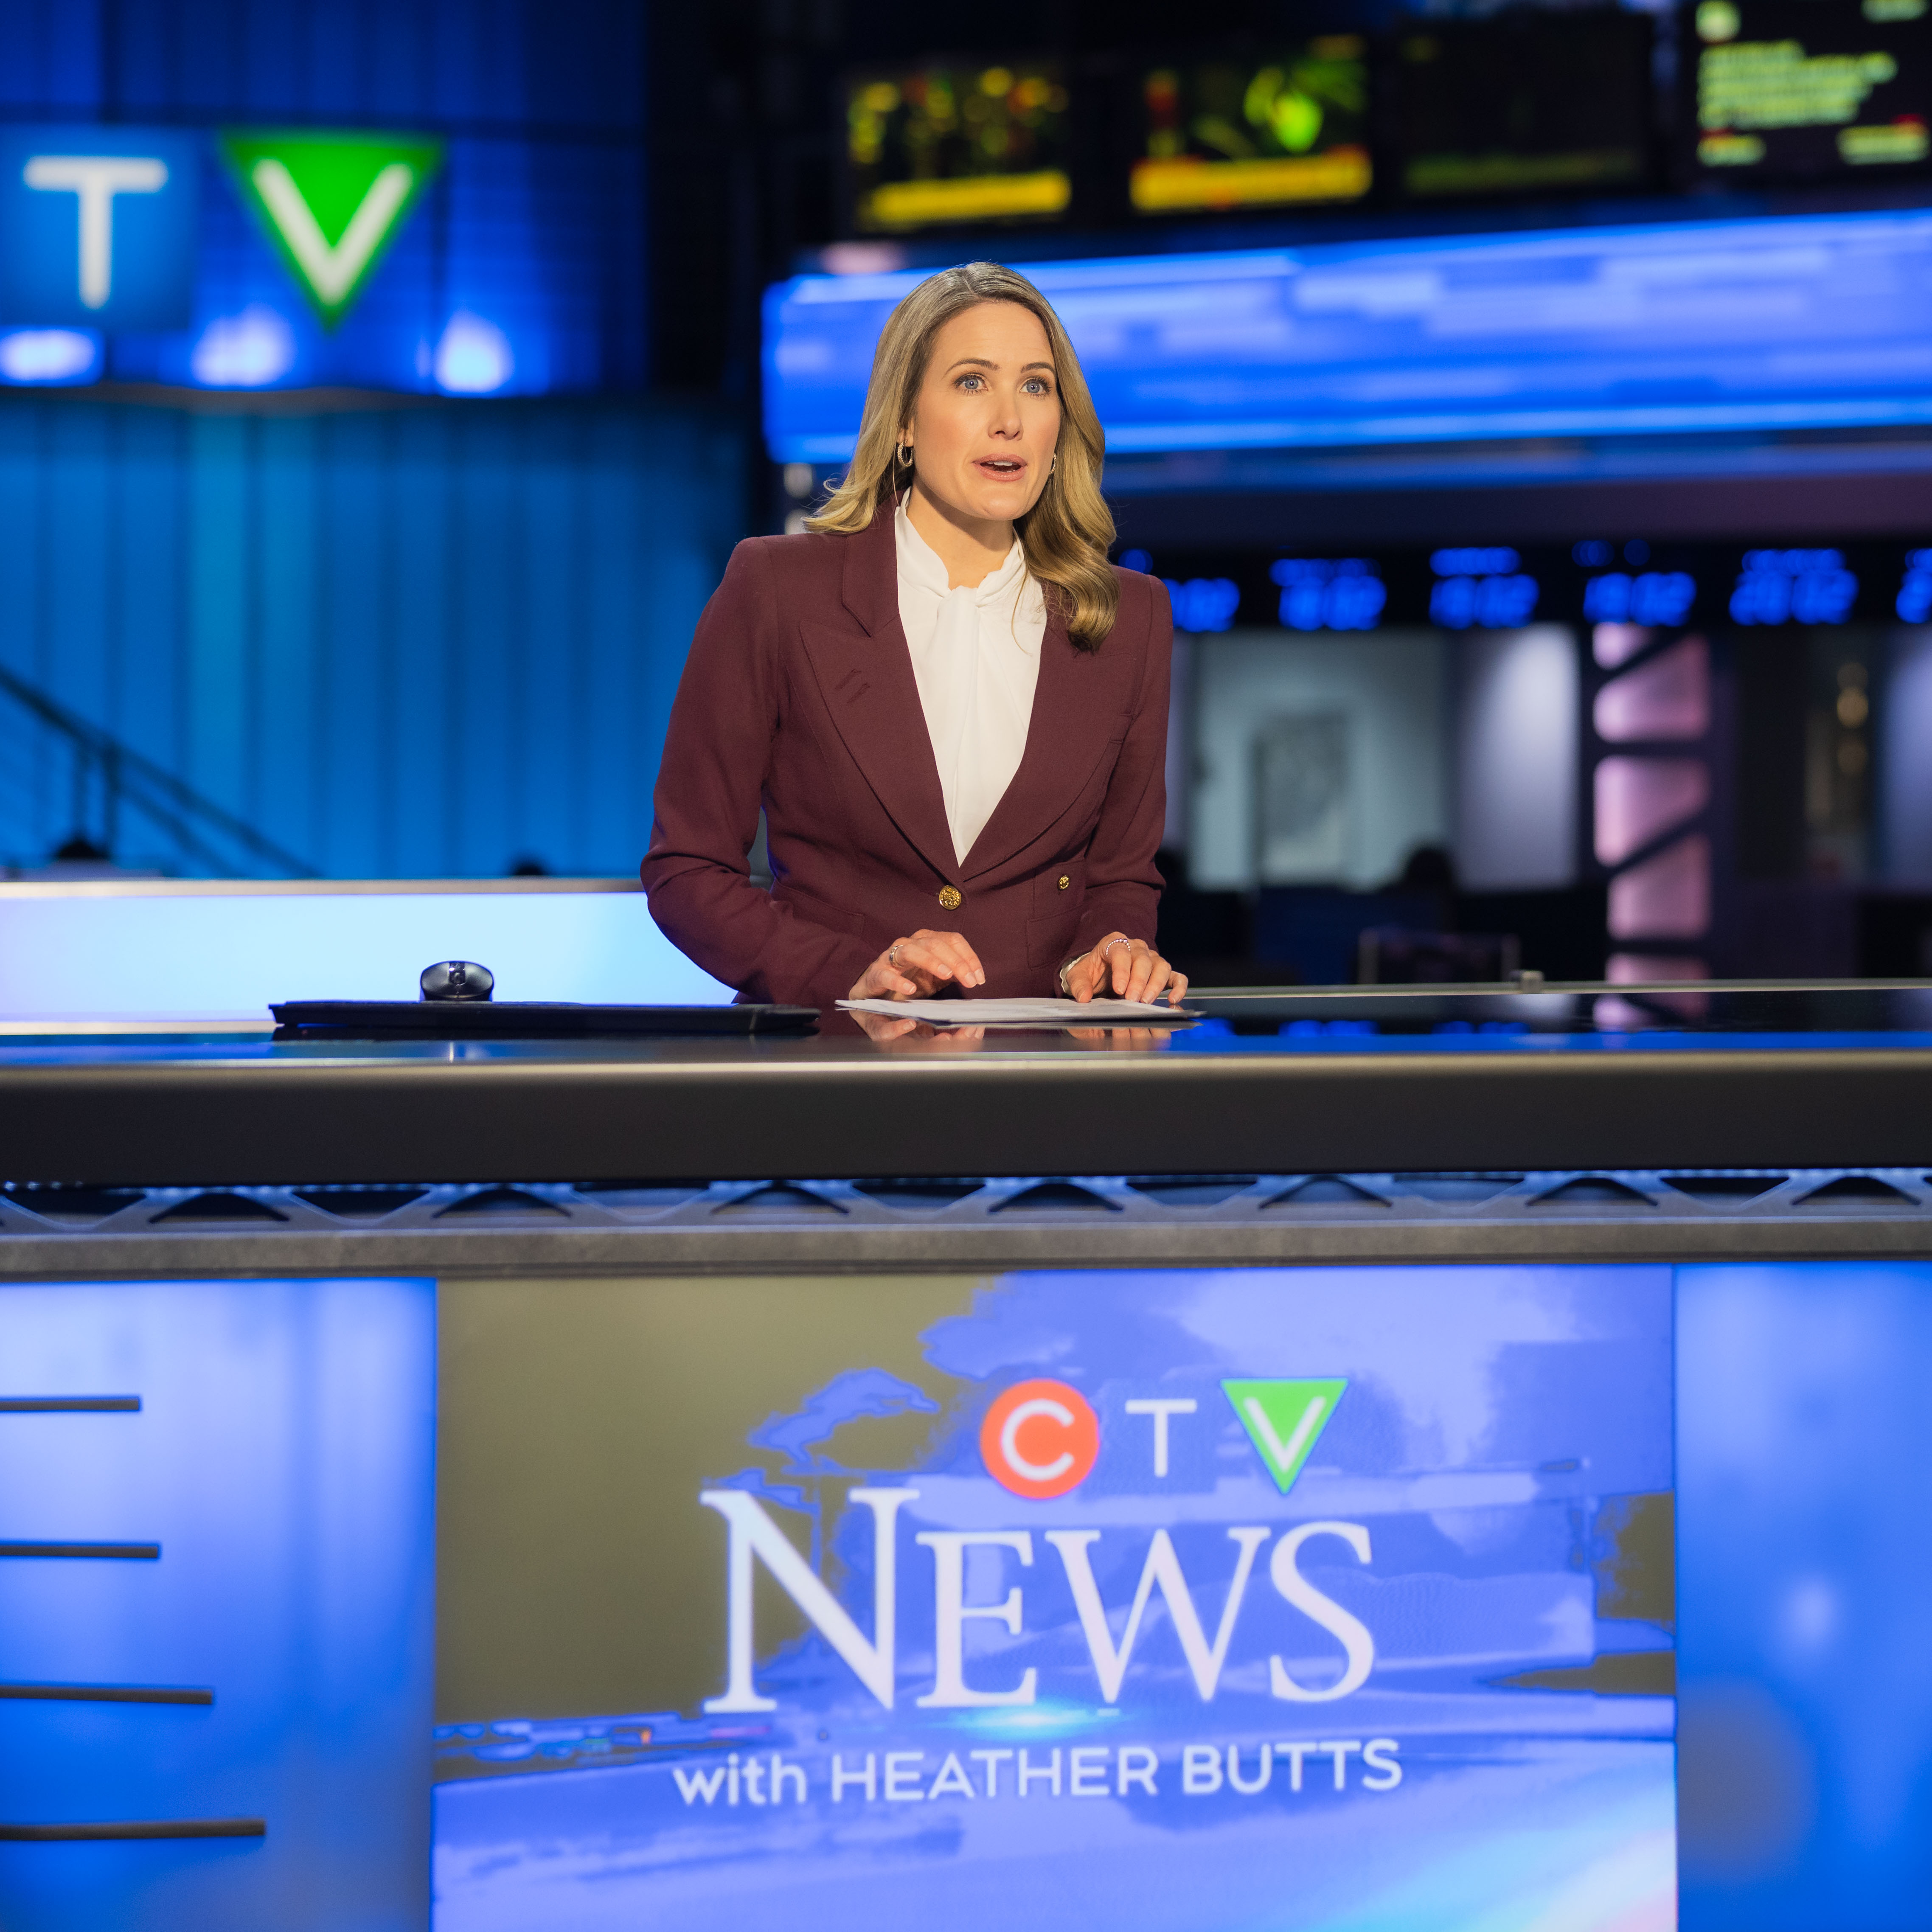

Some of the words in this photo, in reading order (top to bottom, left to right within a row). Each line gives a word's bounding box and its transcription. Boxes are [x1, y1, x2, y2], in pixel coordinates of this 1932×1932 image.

[1000, 1396, 1327, 1482] CTV
[700, 1488, 1374, 1713] NEWS
[673, 1754, 808, 1806] with
[832, 1747, 1158, 1802] HEATHER
[1182, 1740, 1403, 1796] BUTTS
